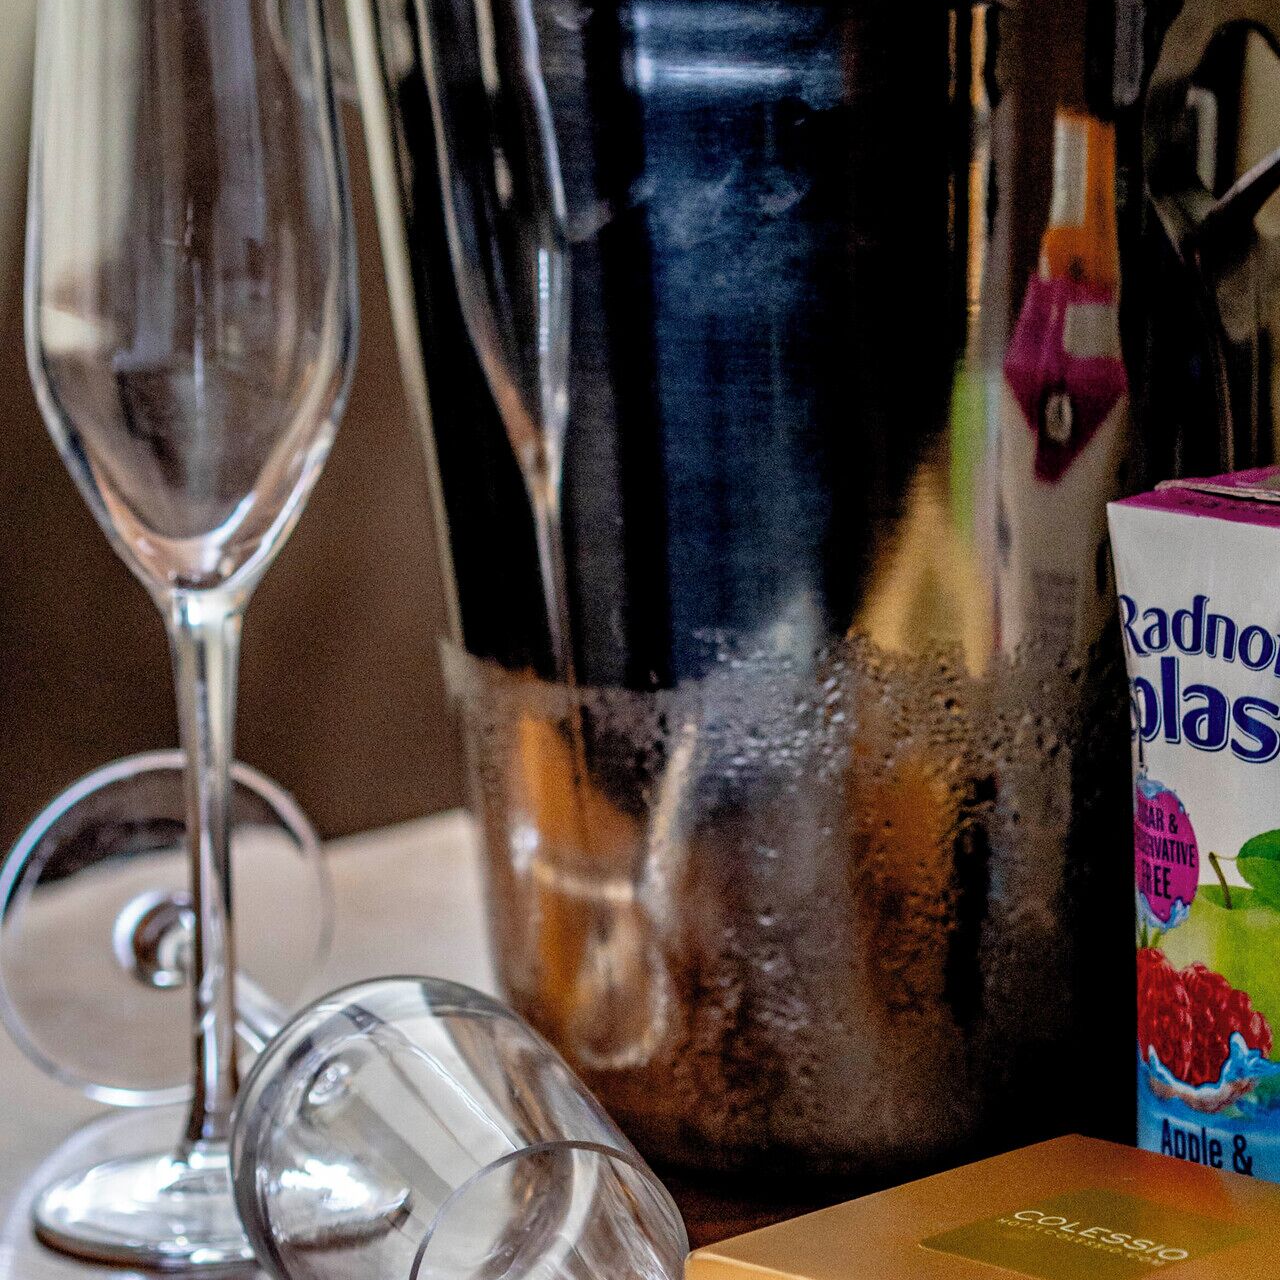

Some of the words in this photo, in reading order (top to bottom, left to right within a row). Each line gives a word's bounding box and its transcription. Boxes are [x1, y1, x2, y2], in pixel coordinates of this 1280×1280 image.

[1169, 813, 1178, 835] &
[1233, 1134, 1254, 1177] &
[1014, 1210, 1189, 1261] COLESSIO
